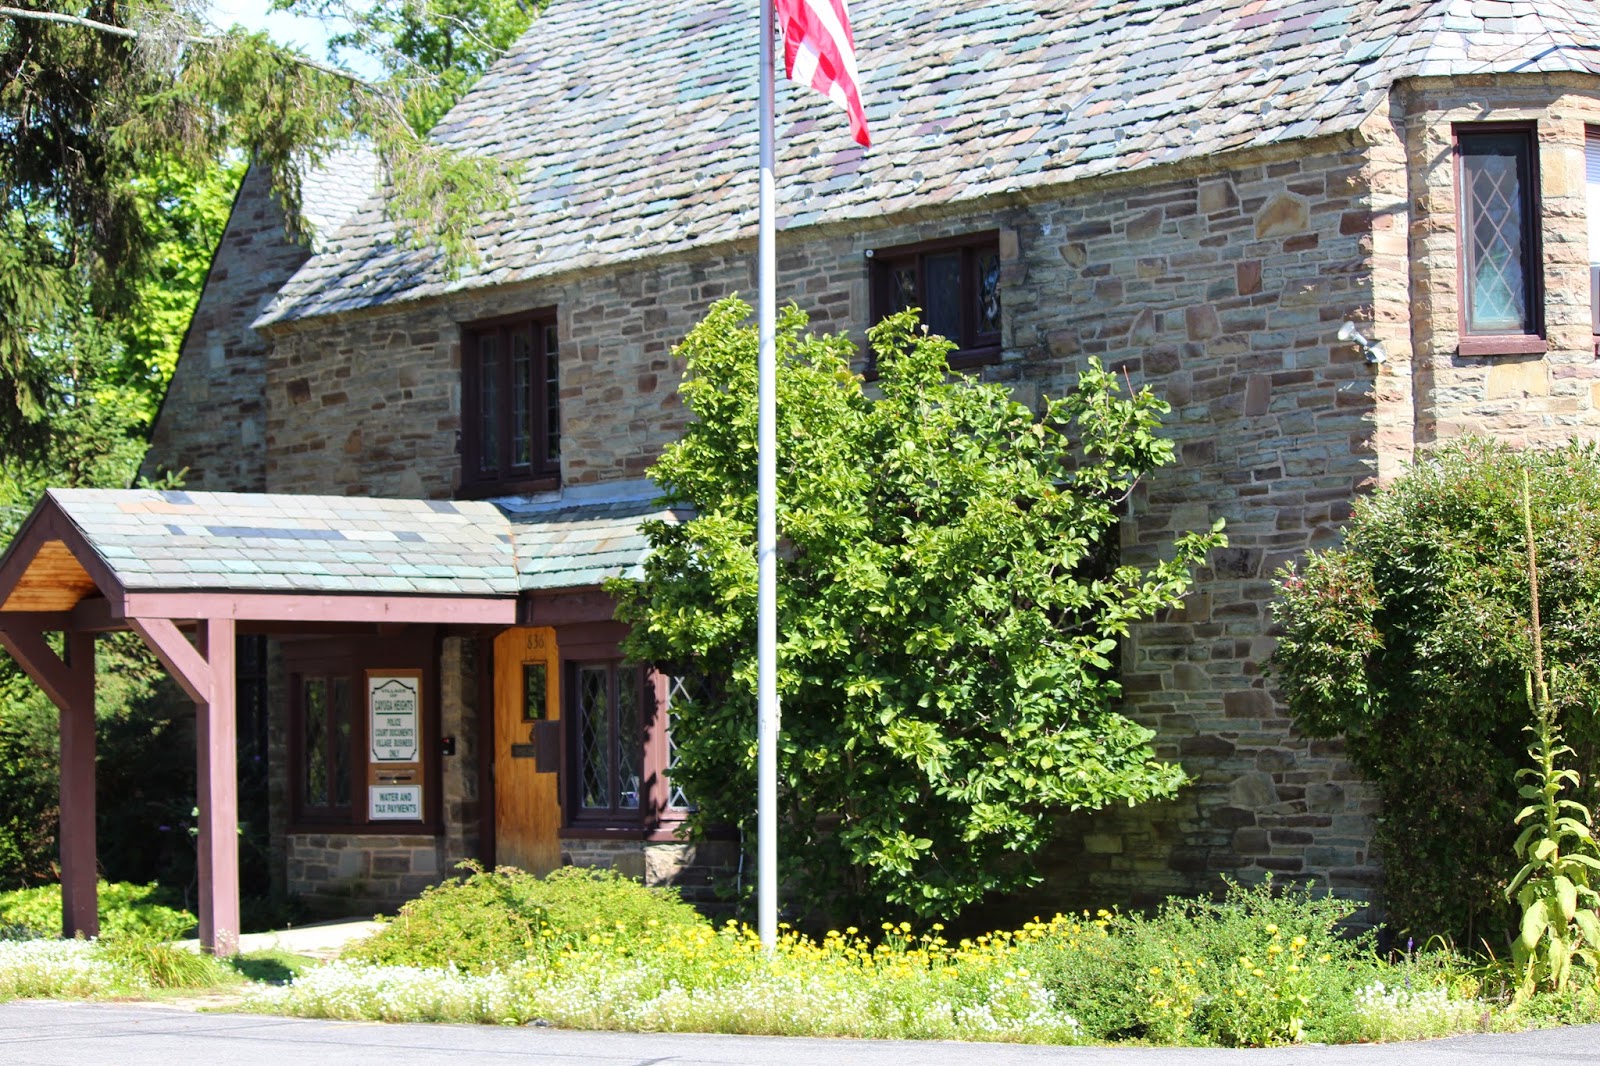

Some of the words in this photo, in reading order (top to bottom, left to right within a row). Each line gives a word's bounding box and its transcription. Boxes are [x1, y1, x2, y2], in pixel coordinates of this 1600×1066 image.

[379, 792, 399, 802] WATER
[400, 792, 412, 802] AND
[375, 804, 386, 813] TAX
[387, 804, 416, 813] PAYMENTS
